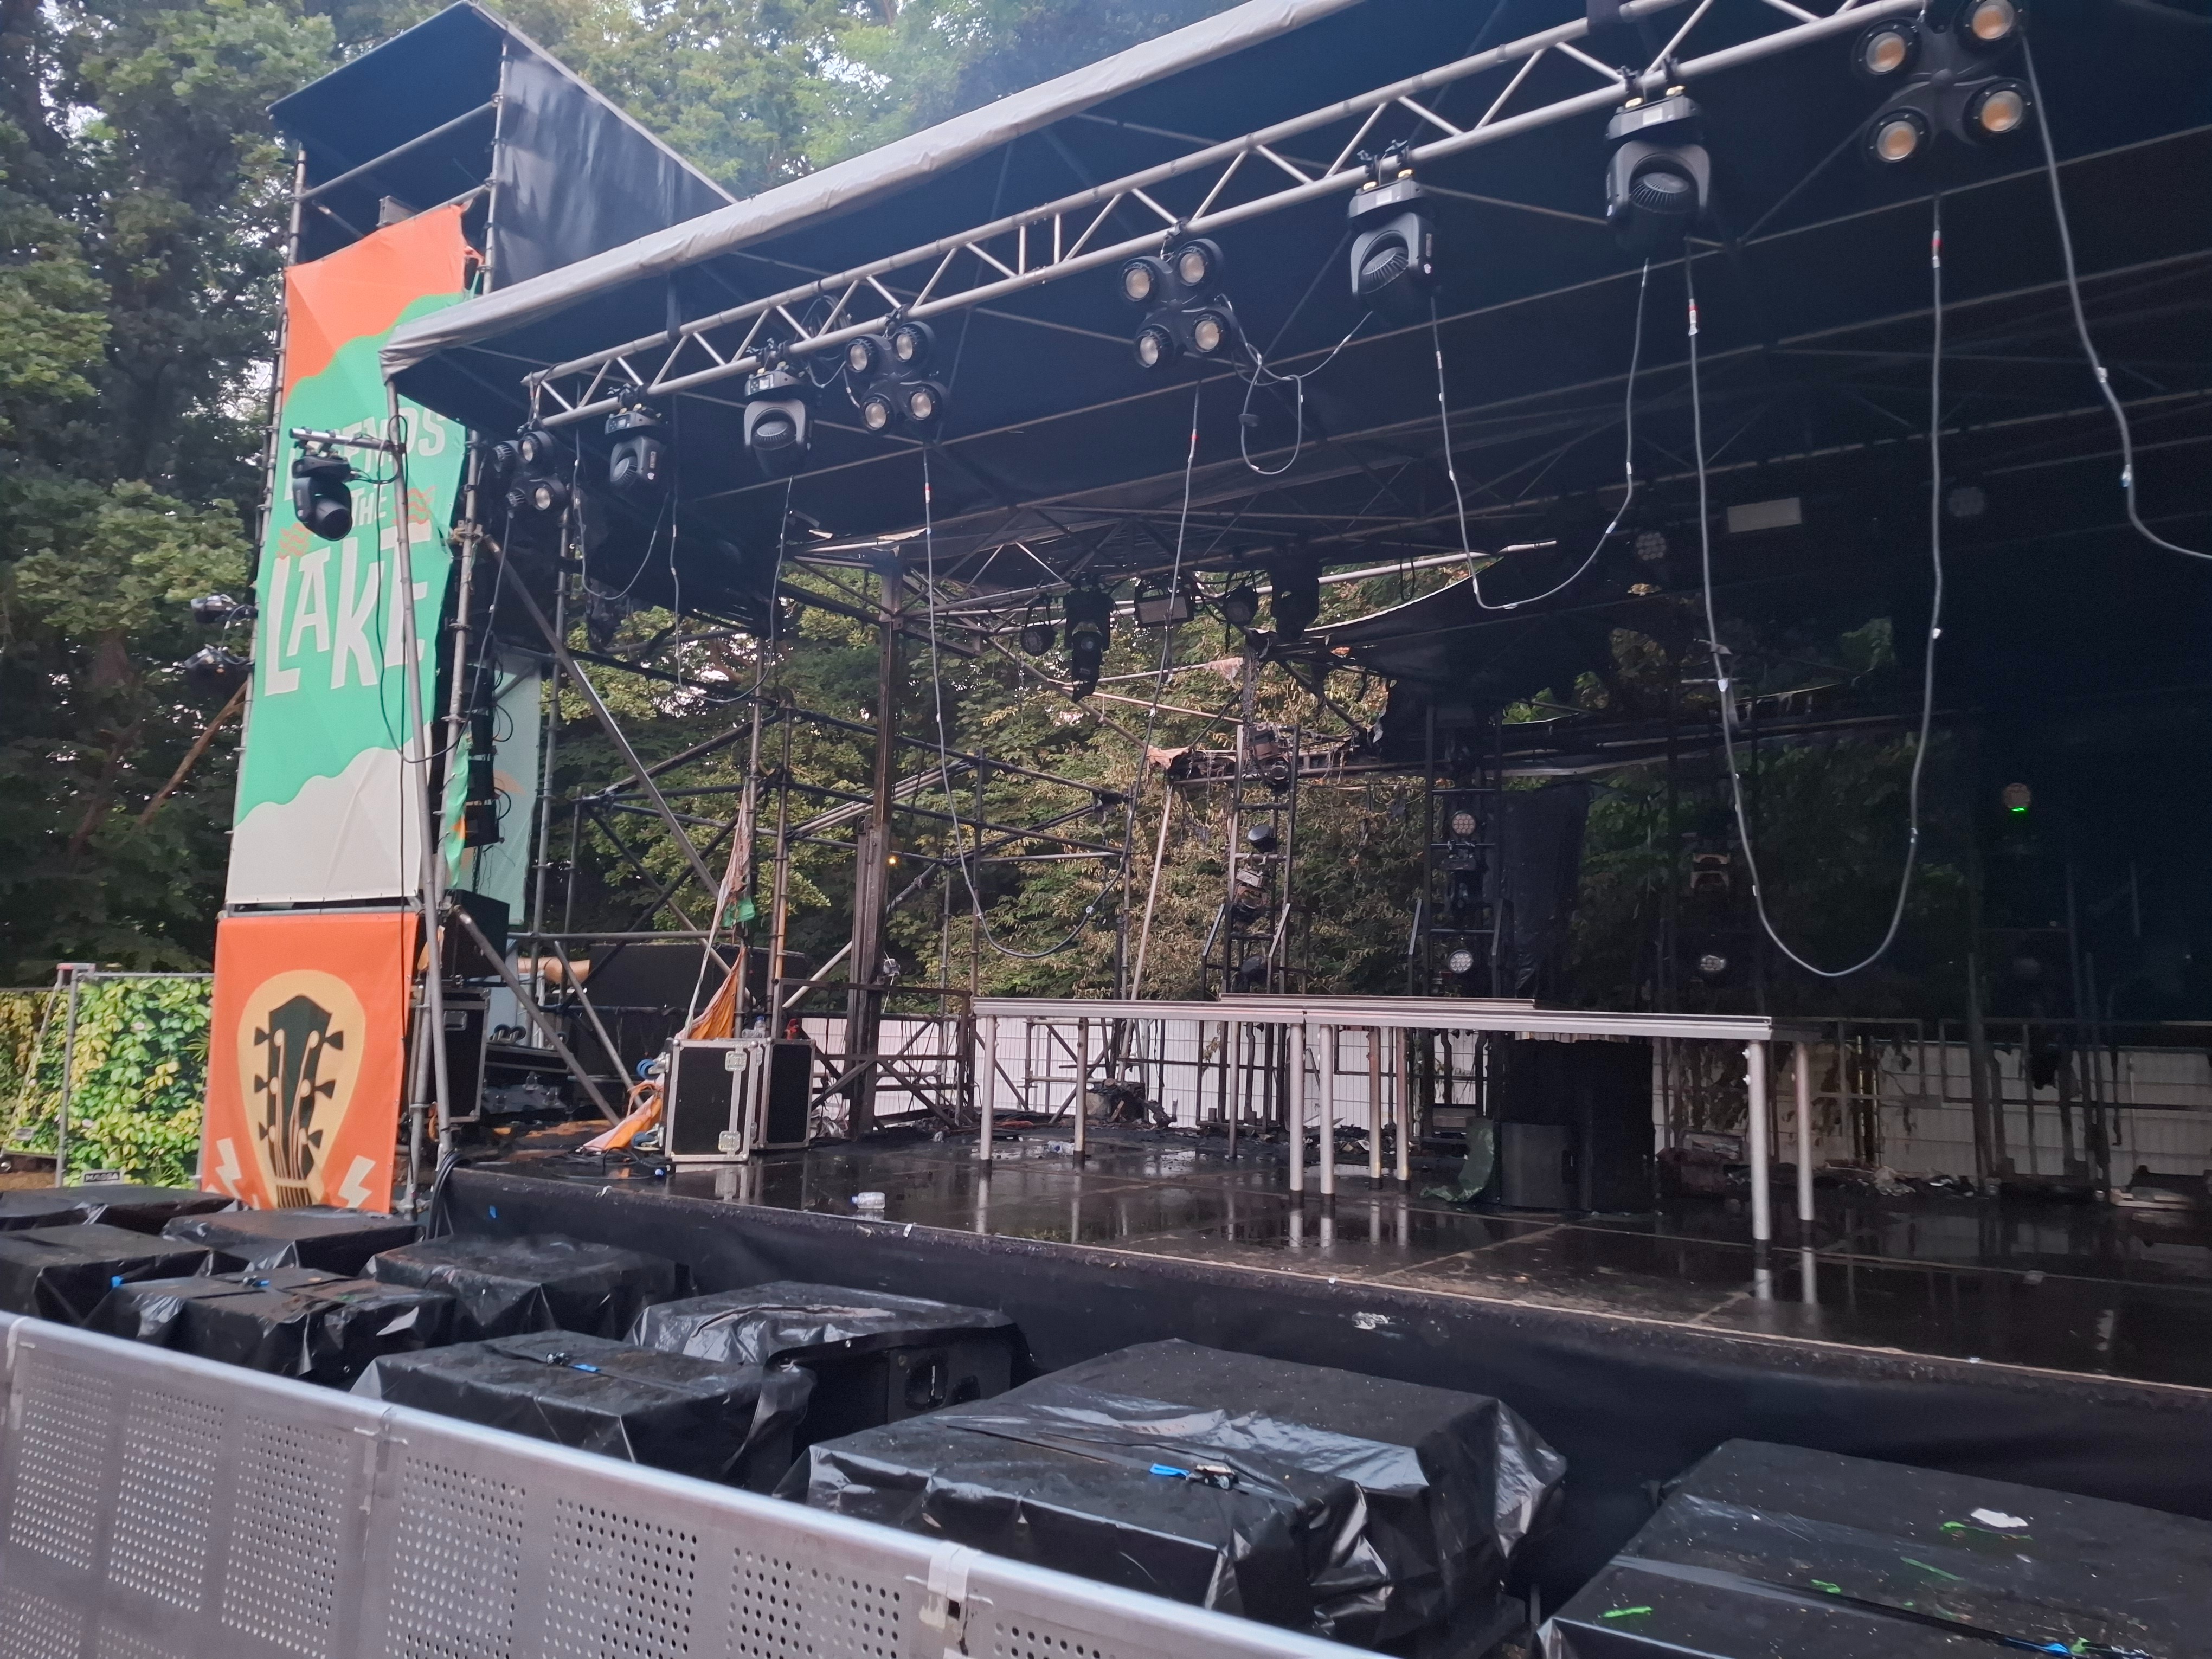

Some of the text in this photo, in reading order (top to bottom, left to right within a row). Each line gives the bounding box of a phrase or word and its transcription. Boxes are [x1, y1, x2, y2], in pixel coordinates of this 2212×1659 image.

[284, 407, 446, 501] LENDS
[350, 483, 387, 528] THE
[264, 519, 432, 696] LAKE
